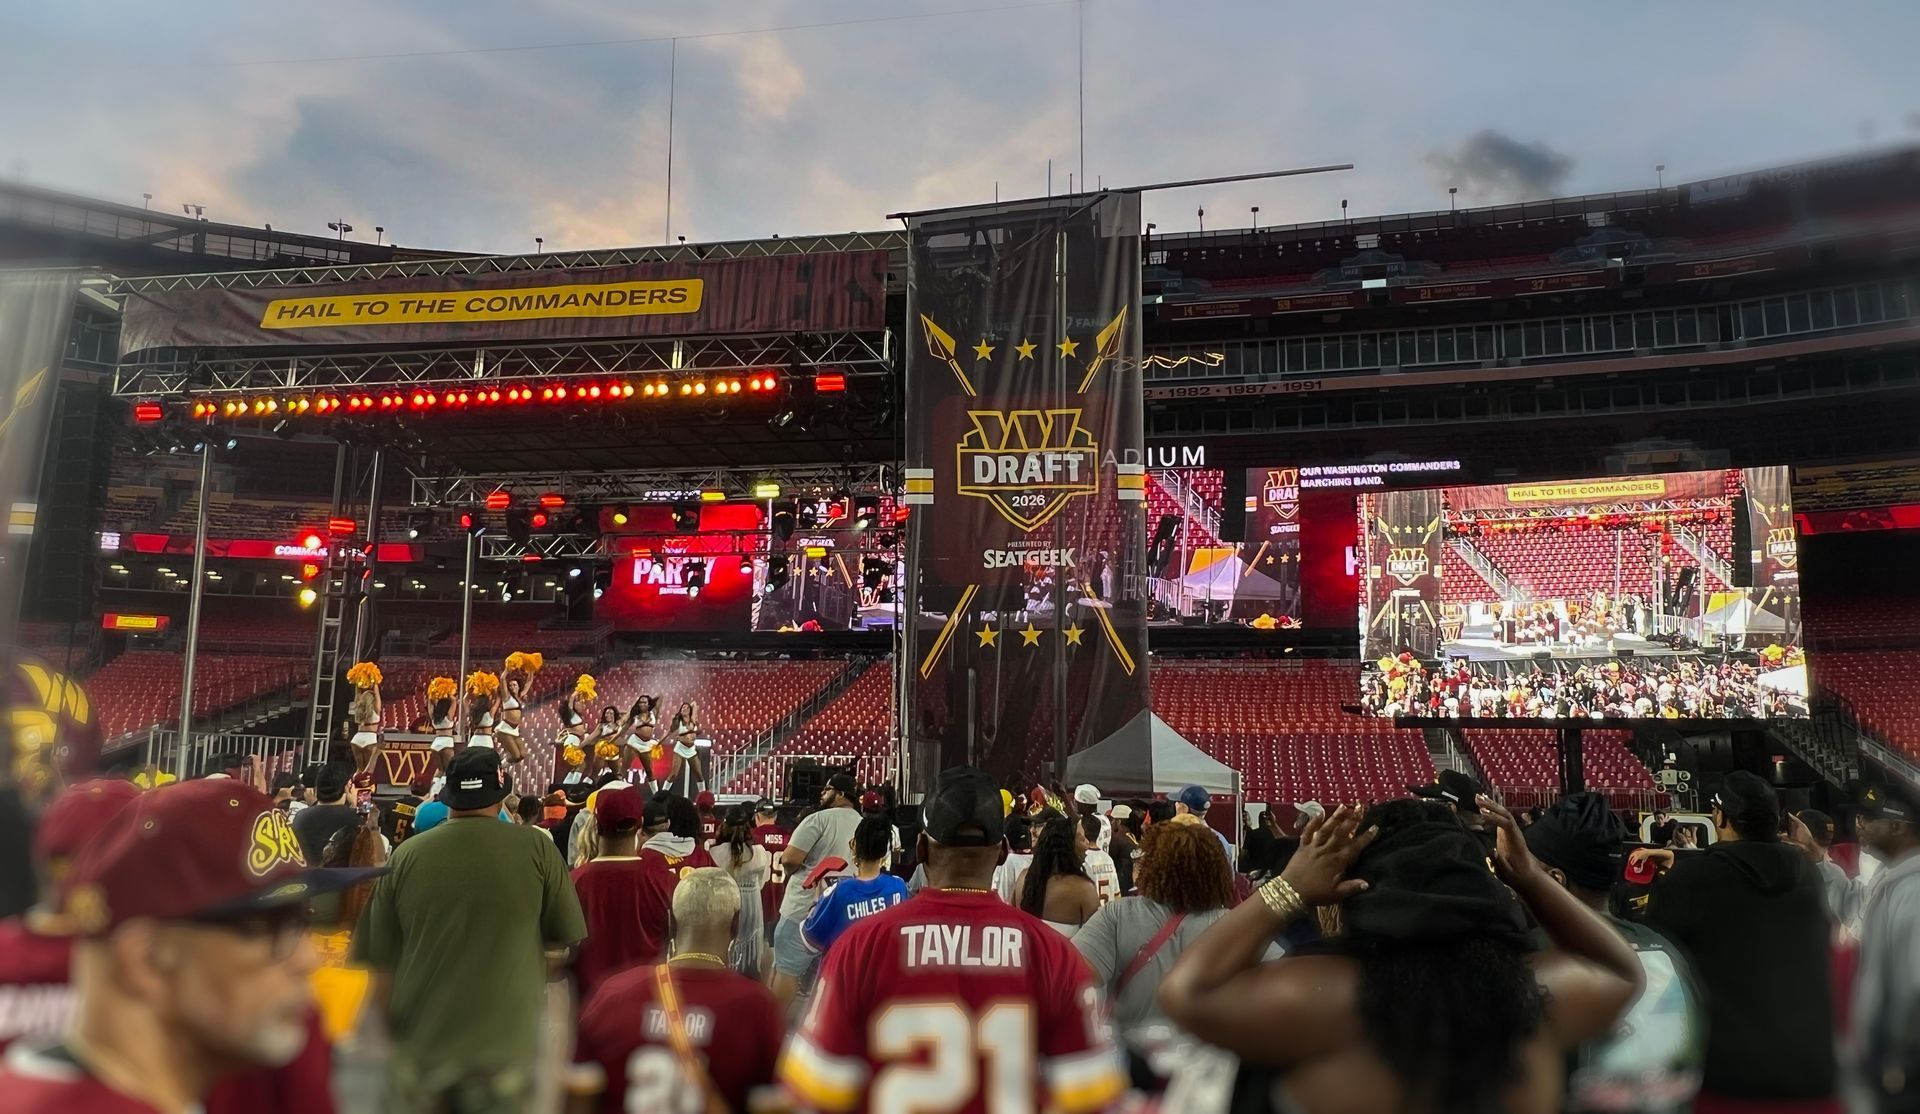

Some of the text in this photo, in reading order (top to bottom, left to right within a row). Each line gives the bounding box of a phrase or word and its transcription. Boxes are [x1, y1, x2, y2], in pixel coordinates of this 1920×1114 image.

[276, 286, 688, 320] HAIL TO THE COMMANDERS
[1168, 386, 1210, 398] 1982
[1226, 384, 1267, 395] 1987
[1283, 381, 1323, 392] 1991
[973, 453, 1084, 489] DRAFT
[1300, 461, 1461, 477] OUR WASHINGTON COMMANDERS
[1301, 476, 1385, 488] MARCHING BAND.
[1557, 487, 1577, 495] THE
[1580, 483, 1660, 494] COMMANDERS
[1012, 494, 1046, 507] 2026
[1008, 541, 1042, 549] PRESENTED
[984, 548, 1076, 568] SEATGEEK
[1391, 561, 1425, 571] DRAFT
[765, 833, 783, 845] MOSS
[1097, 880, 1110, 906] 5
[847, 896, 887, 920] CHILES
[901, 924, 1022, 968] TAYLOR
[650, 1009, 706, 1038] TAOR
[873, 1001, 1033, 1114] 21
